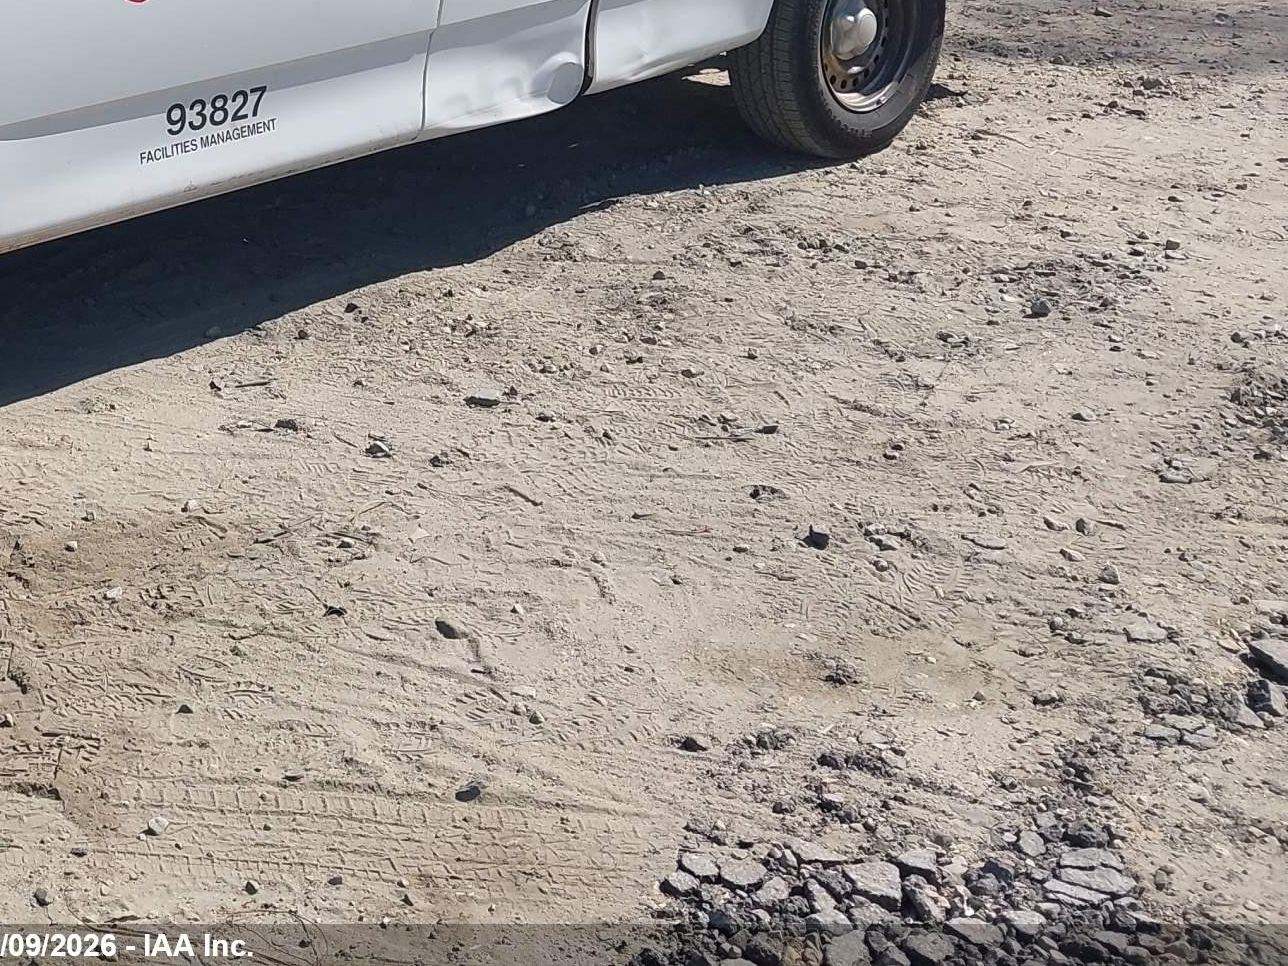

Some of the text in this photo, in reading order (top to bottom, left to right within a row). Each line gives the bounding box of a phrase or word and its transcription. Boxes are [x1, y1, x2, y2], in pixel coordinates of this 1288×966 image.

[166, 85, 268, 136] 93827
[139, 118, 278, 165] FACILITIES MANAGEMENT
